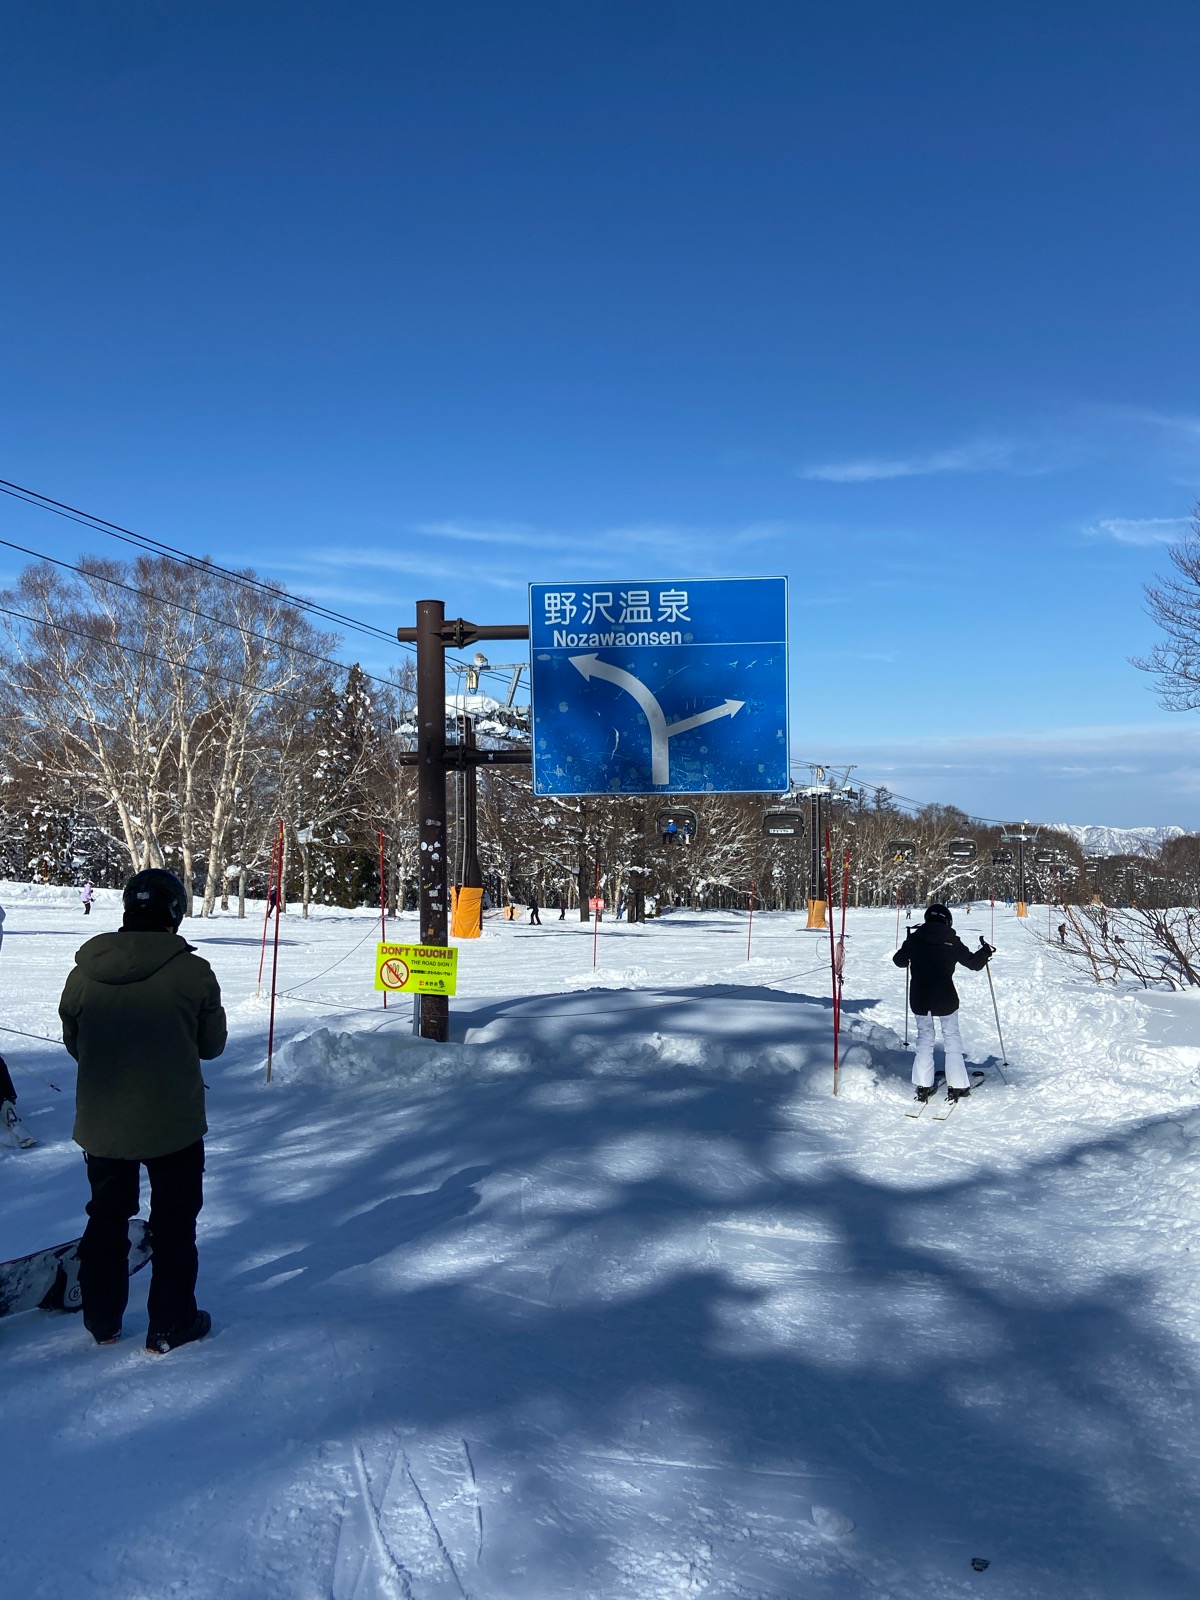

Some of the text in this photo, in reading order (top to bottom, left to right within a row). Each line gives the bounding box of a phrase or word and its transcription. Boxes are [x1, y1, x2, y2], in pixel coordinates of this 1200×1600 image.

[543, 588, 692, 626] 野沢温泉
[552, 629, 683, 648] Nozawaonsen
[381, 946, 411, 956] DON'T
